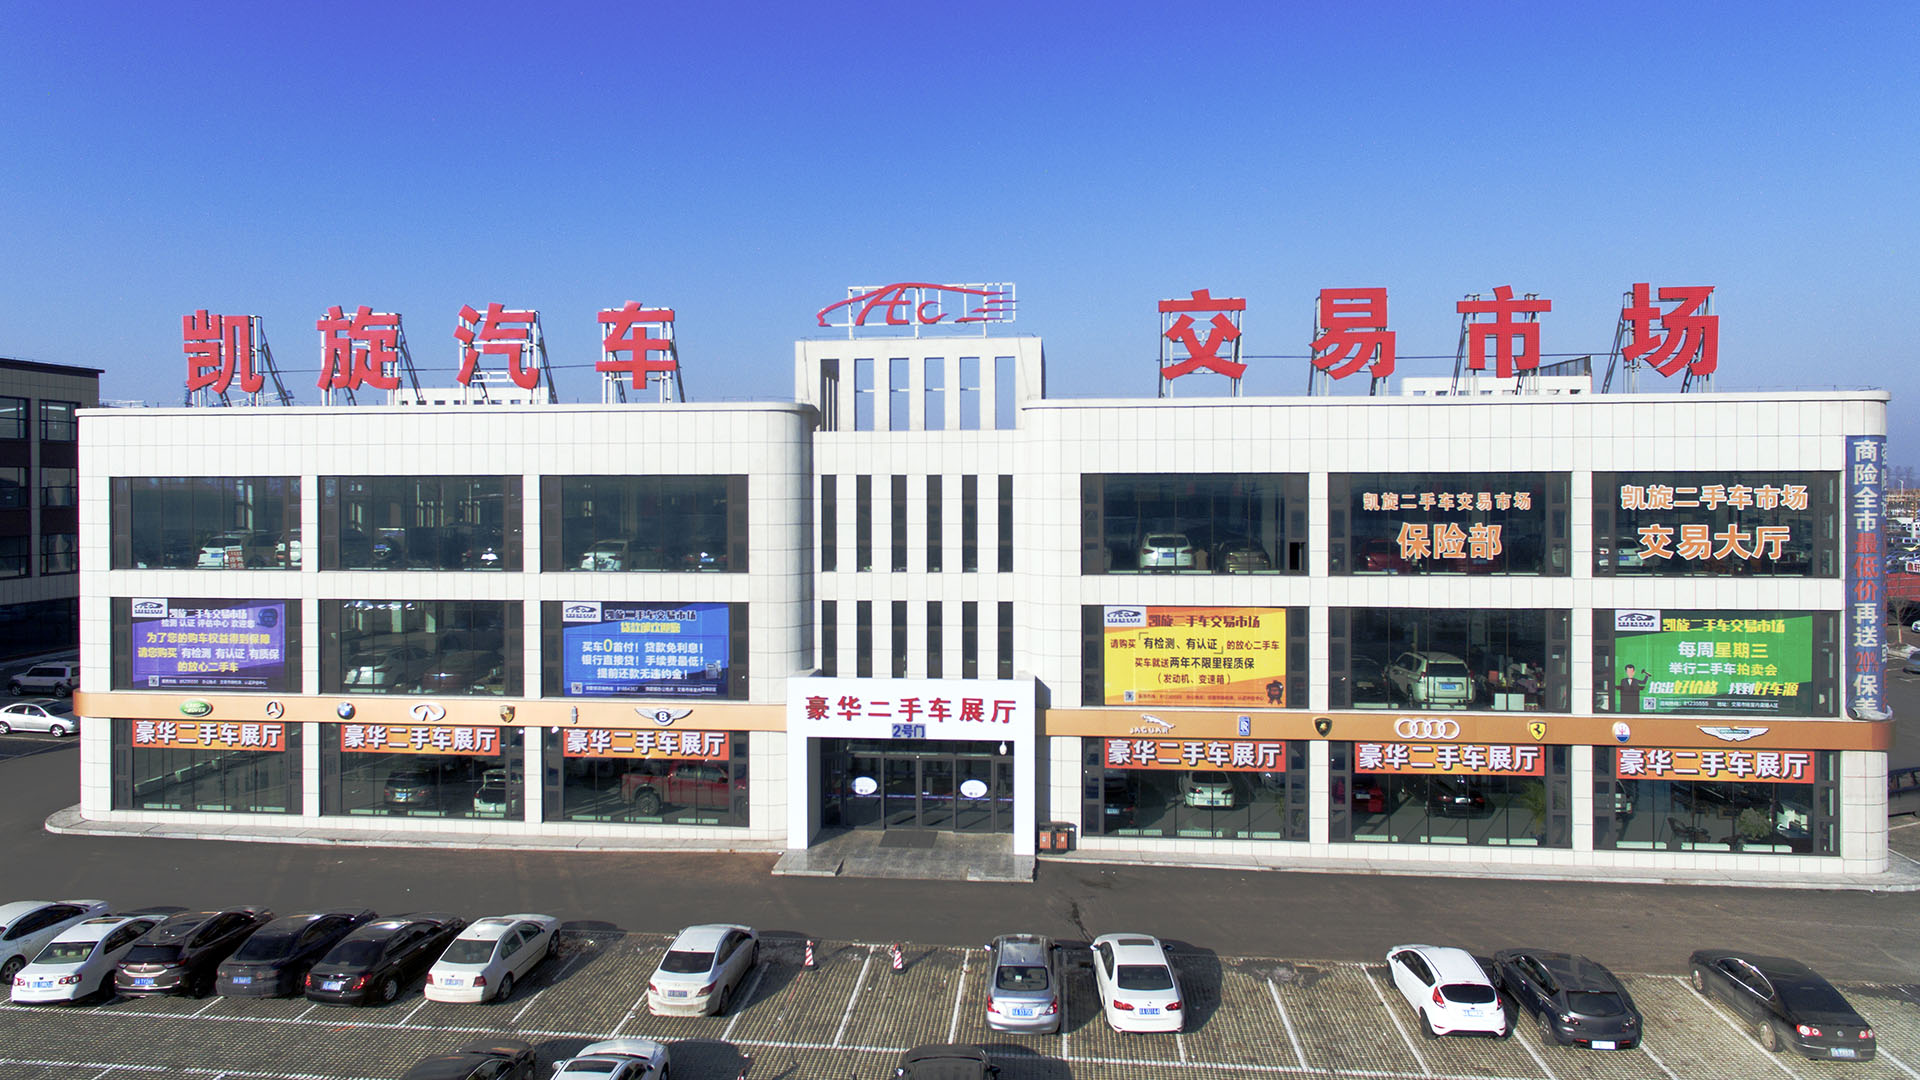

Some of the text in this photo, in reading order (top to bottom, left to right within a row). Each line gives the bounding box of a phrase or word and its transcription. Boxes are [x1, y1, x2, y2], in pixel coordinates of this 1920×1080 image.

[182, 283, 1719, 393] 凯旋汽车 交易市场
[1363, 492, 1532, 511] 凯旋二手车交易市场
[1621, 484, 1808, 510] 凯旋二手车市场
[1396, 522, 1503, 560] 保险部
[1637, 523, 1791, 560] 交易大厅
[1148, 615, 1260, 628] 凯旋二手车交易市场
[1663, 618, 1785, 633] 凯旋二手车交易市场
[181, 648, 212, 660] 有检测
[215, 648, 245, 660] 有认证
[1135, 657, 1255, 669] 买车就送两年不限里程质保
[1678, 641, 1769, 659] 每周星期三
[177, 661, 239, 673] 的放心二手车
[1669, 662, 1778, 676] 举行二手车拍卖会
[1649, 680, 1800, 696] 拍出好价格 找到好车源
[805, 695, 1016, 724] 豪华二手车展厅
[136, 721, 282, 747] 豪华二手车展厅
[344, 725, 496, 751] 豪华二手车展厅
[567, 729, 726, 756] 豪华二手车展厅
[892, 724, 925, 738] 2号门
[1108, 739, 1282, 767] 豪华二手车展厅
[1359, 743, 1539, 772] 豪华二手车展厅
[1619, 749, 1809, 778] 豪华二手车展厅
